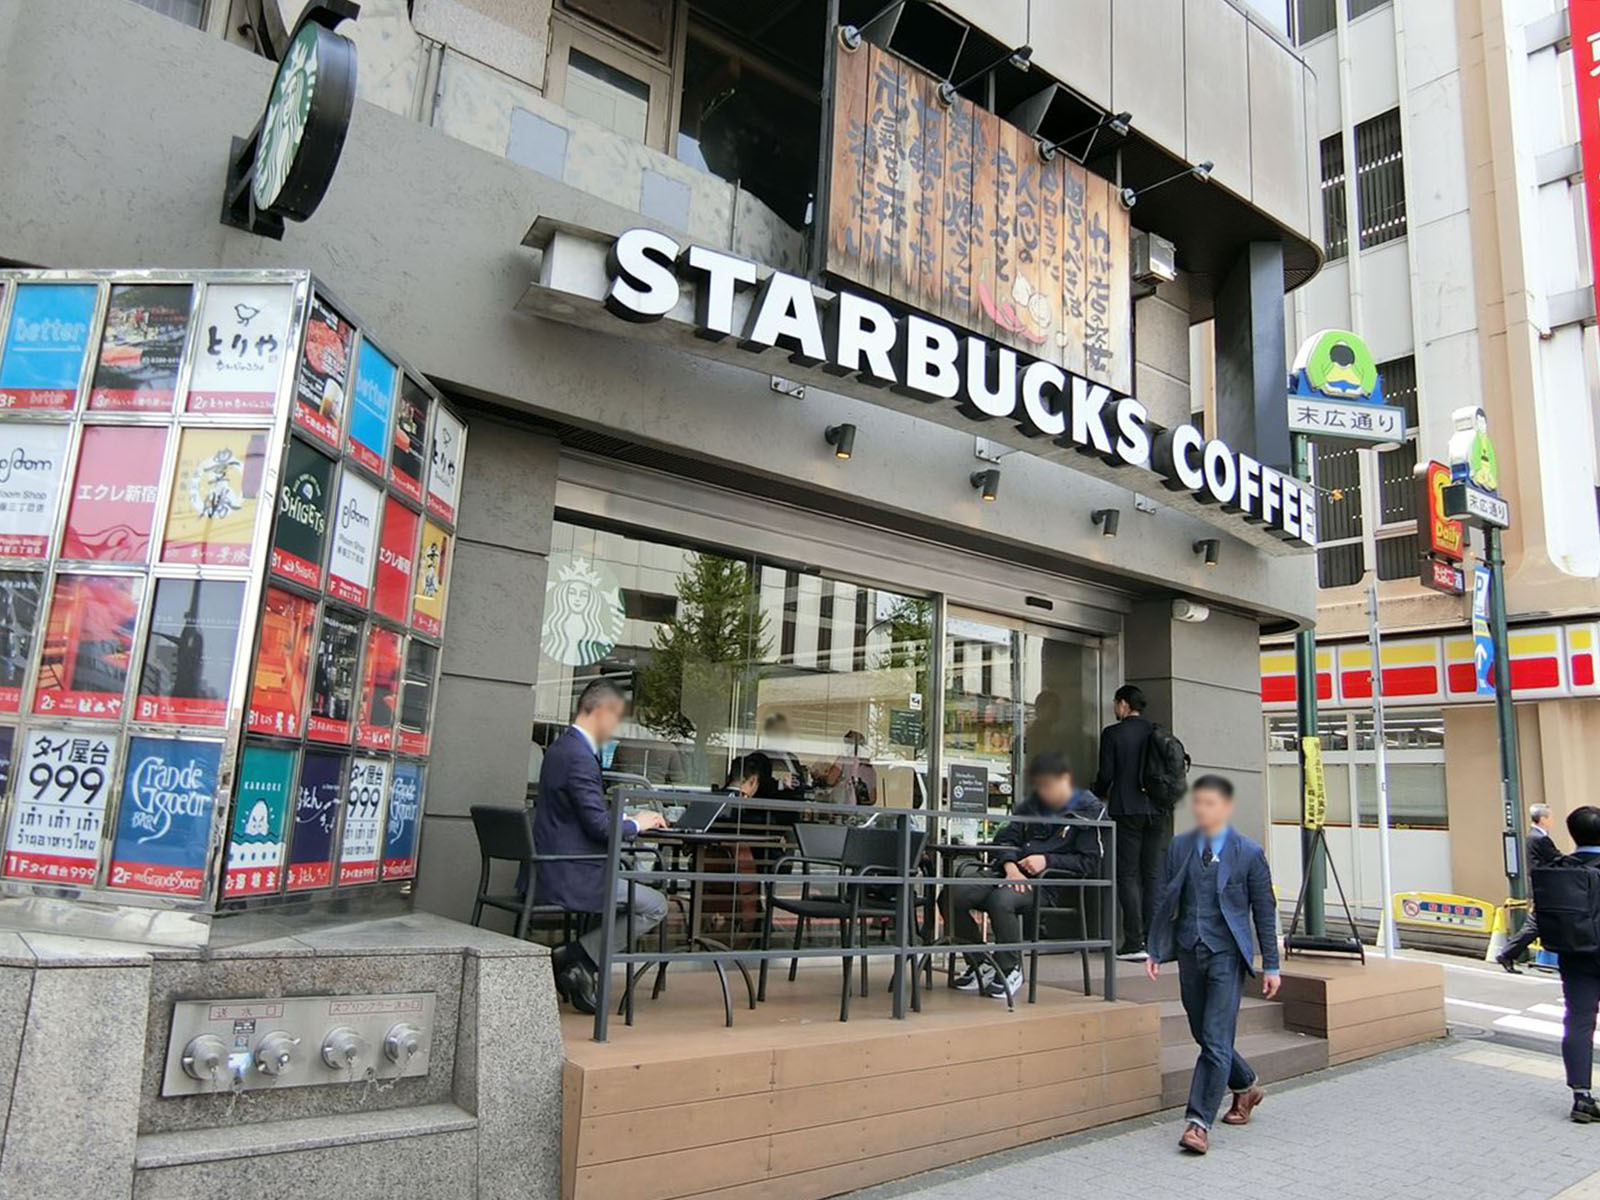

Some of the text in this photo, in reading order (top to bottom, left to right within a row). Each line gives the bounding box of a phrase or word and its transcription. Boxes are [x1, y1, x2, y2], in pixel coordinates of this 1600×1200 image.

[14, 317, 86, 343] better
[207, 325, 278, 357] とりや
[608, 228, 1151, 467] STARBUCKS
[1171, 424, 1317, 546] COFFEE
[1297, 406, 1395, 433] 末広通り
[77, 484, 159, 504] エクレ新宿
[142, 701, 159, 719] B1
[32, 735, 110, 766] タイ屋台
[29, 762, 105, 805] 999
[243, 780, 282, 793] KARAOKE
[348, 786, 381, 819] 999
[113, 866, 132, 884] 2F
